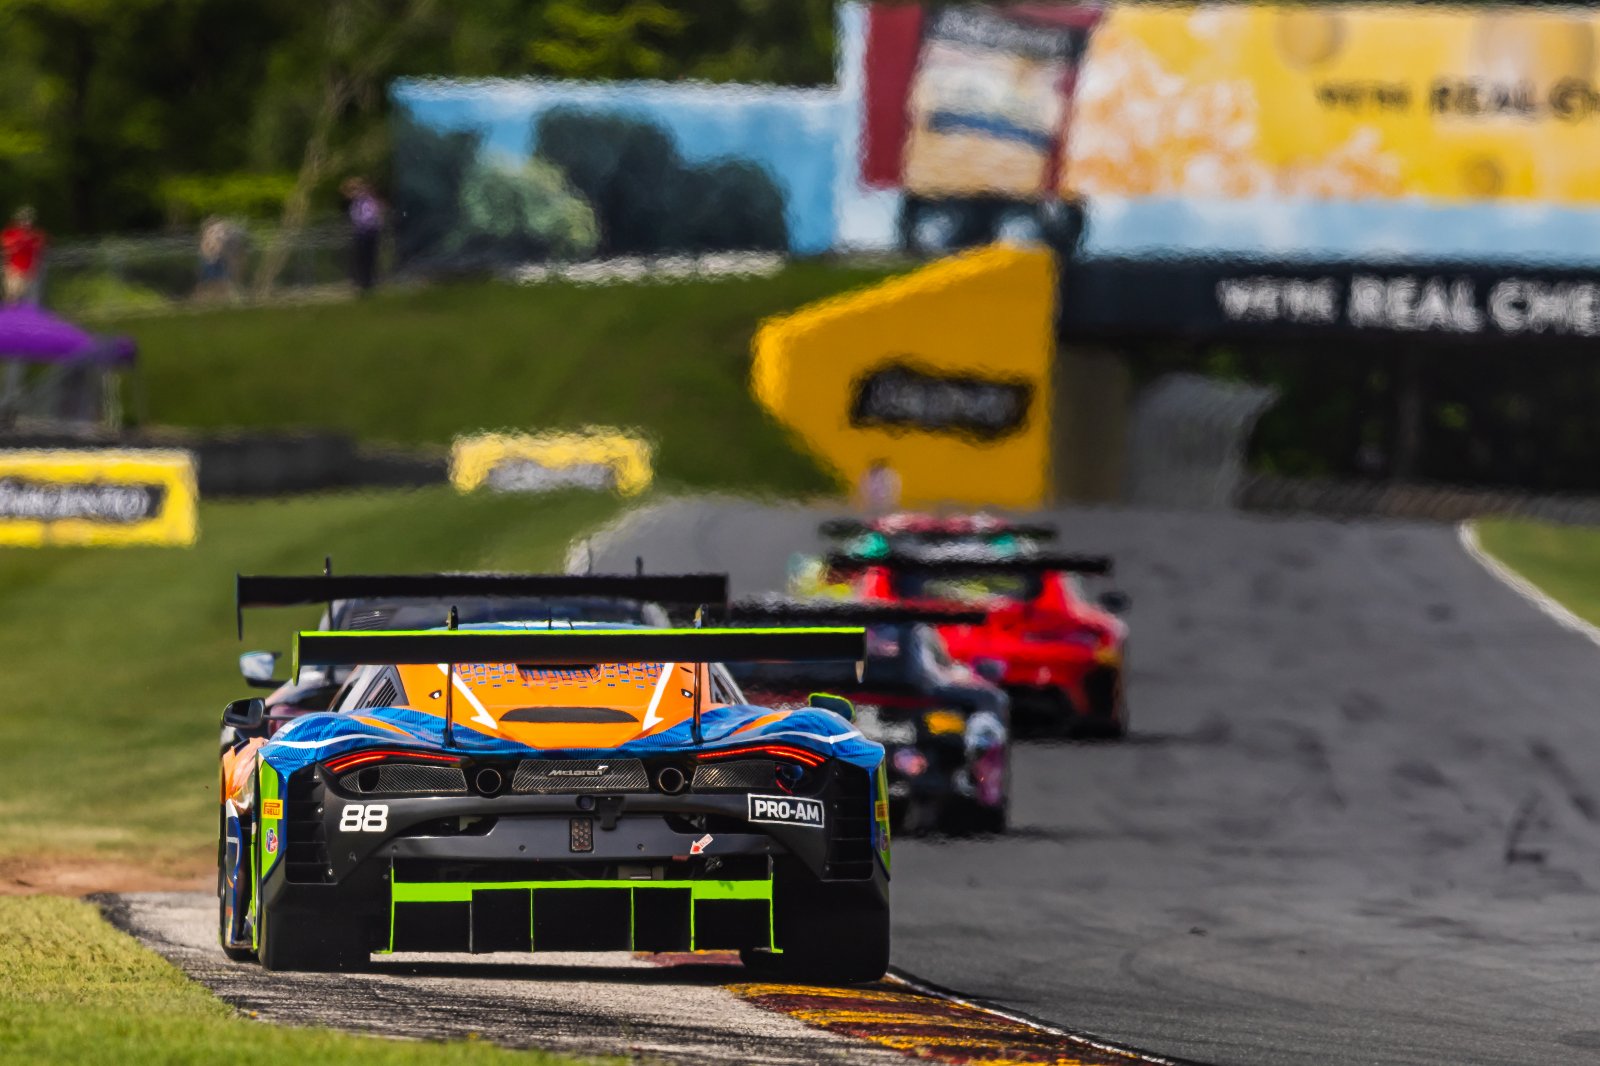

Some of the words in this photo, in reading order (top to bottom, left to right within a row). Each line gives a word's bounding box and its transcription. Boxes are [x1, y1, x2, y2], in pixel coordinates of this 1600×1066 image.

[1349, 275, 1484, 332] REAL
[547, 768, 603, 776] McLaren
[339, 804, 389, 832] 88
[755, 800, 820, 821] PRO-AM
